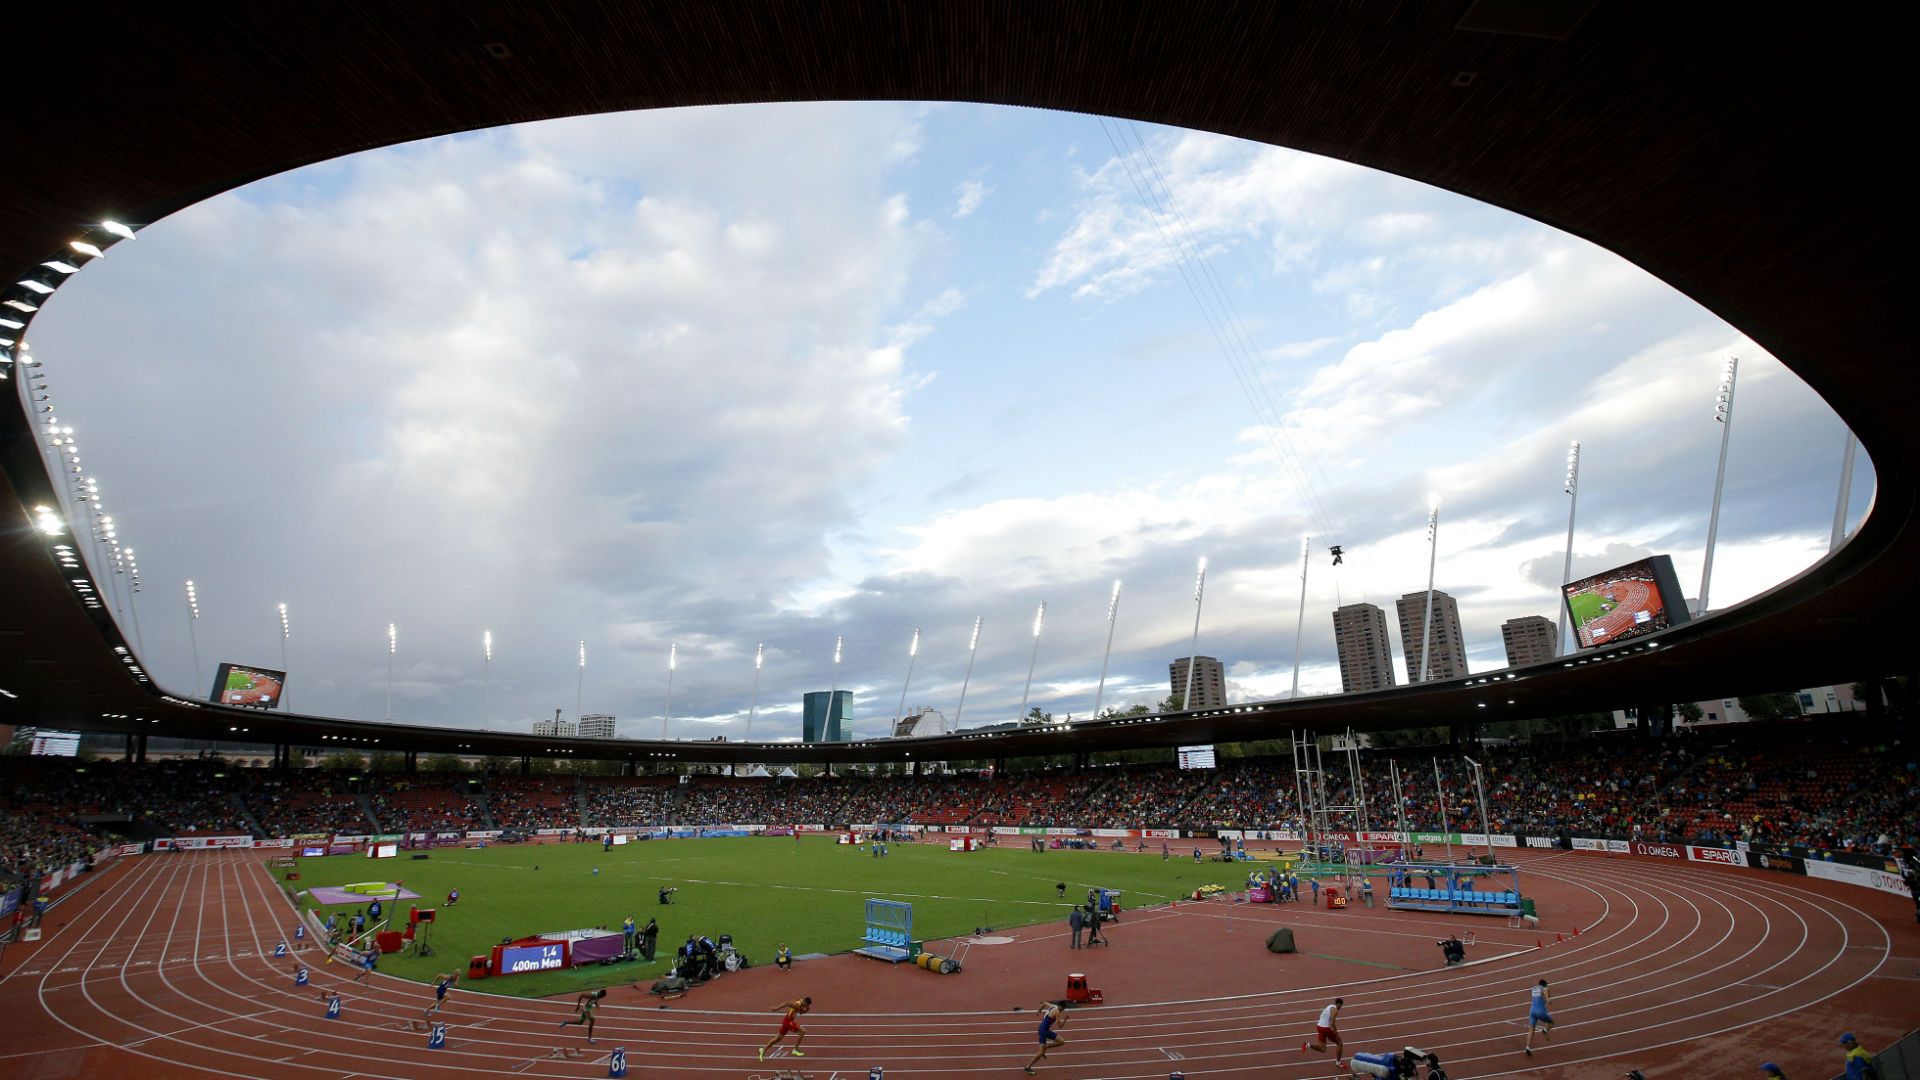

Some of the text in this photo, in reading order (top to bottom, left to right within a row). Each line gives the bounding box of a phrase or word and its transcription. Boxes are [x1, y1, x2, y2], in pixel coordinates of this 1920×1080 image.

[1526, 837, 1552, 848] PUMA
[1648, 846, 1680, 858] OMEGA
[1702, 849, 1731, 862] SPAR
[297, 926, 305, 937] 1
[277, 943, 287, 955] 2
[543, 946, 557, 958] 1.4
[512, 958, 562, 972] 400m Men
[298, 969, 309, 982] 3
[329, 999, 339, 1015] 4
